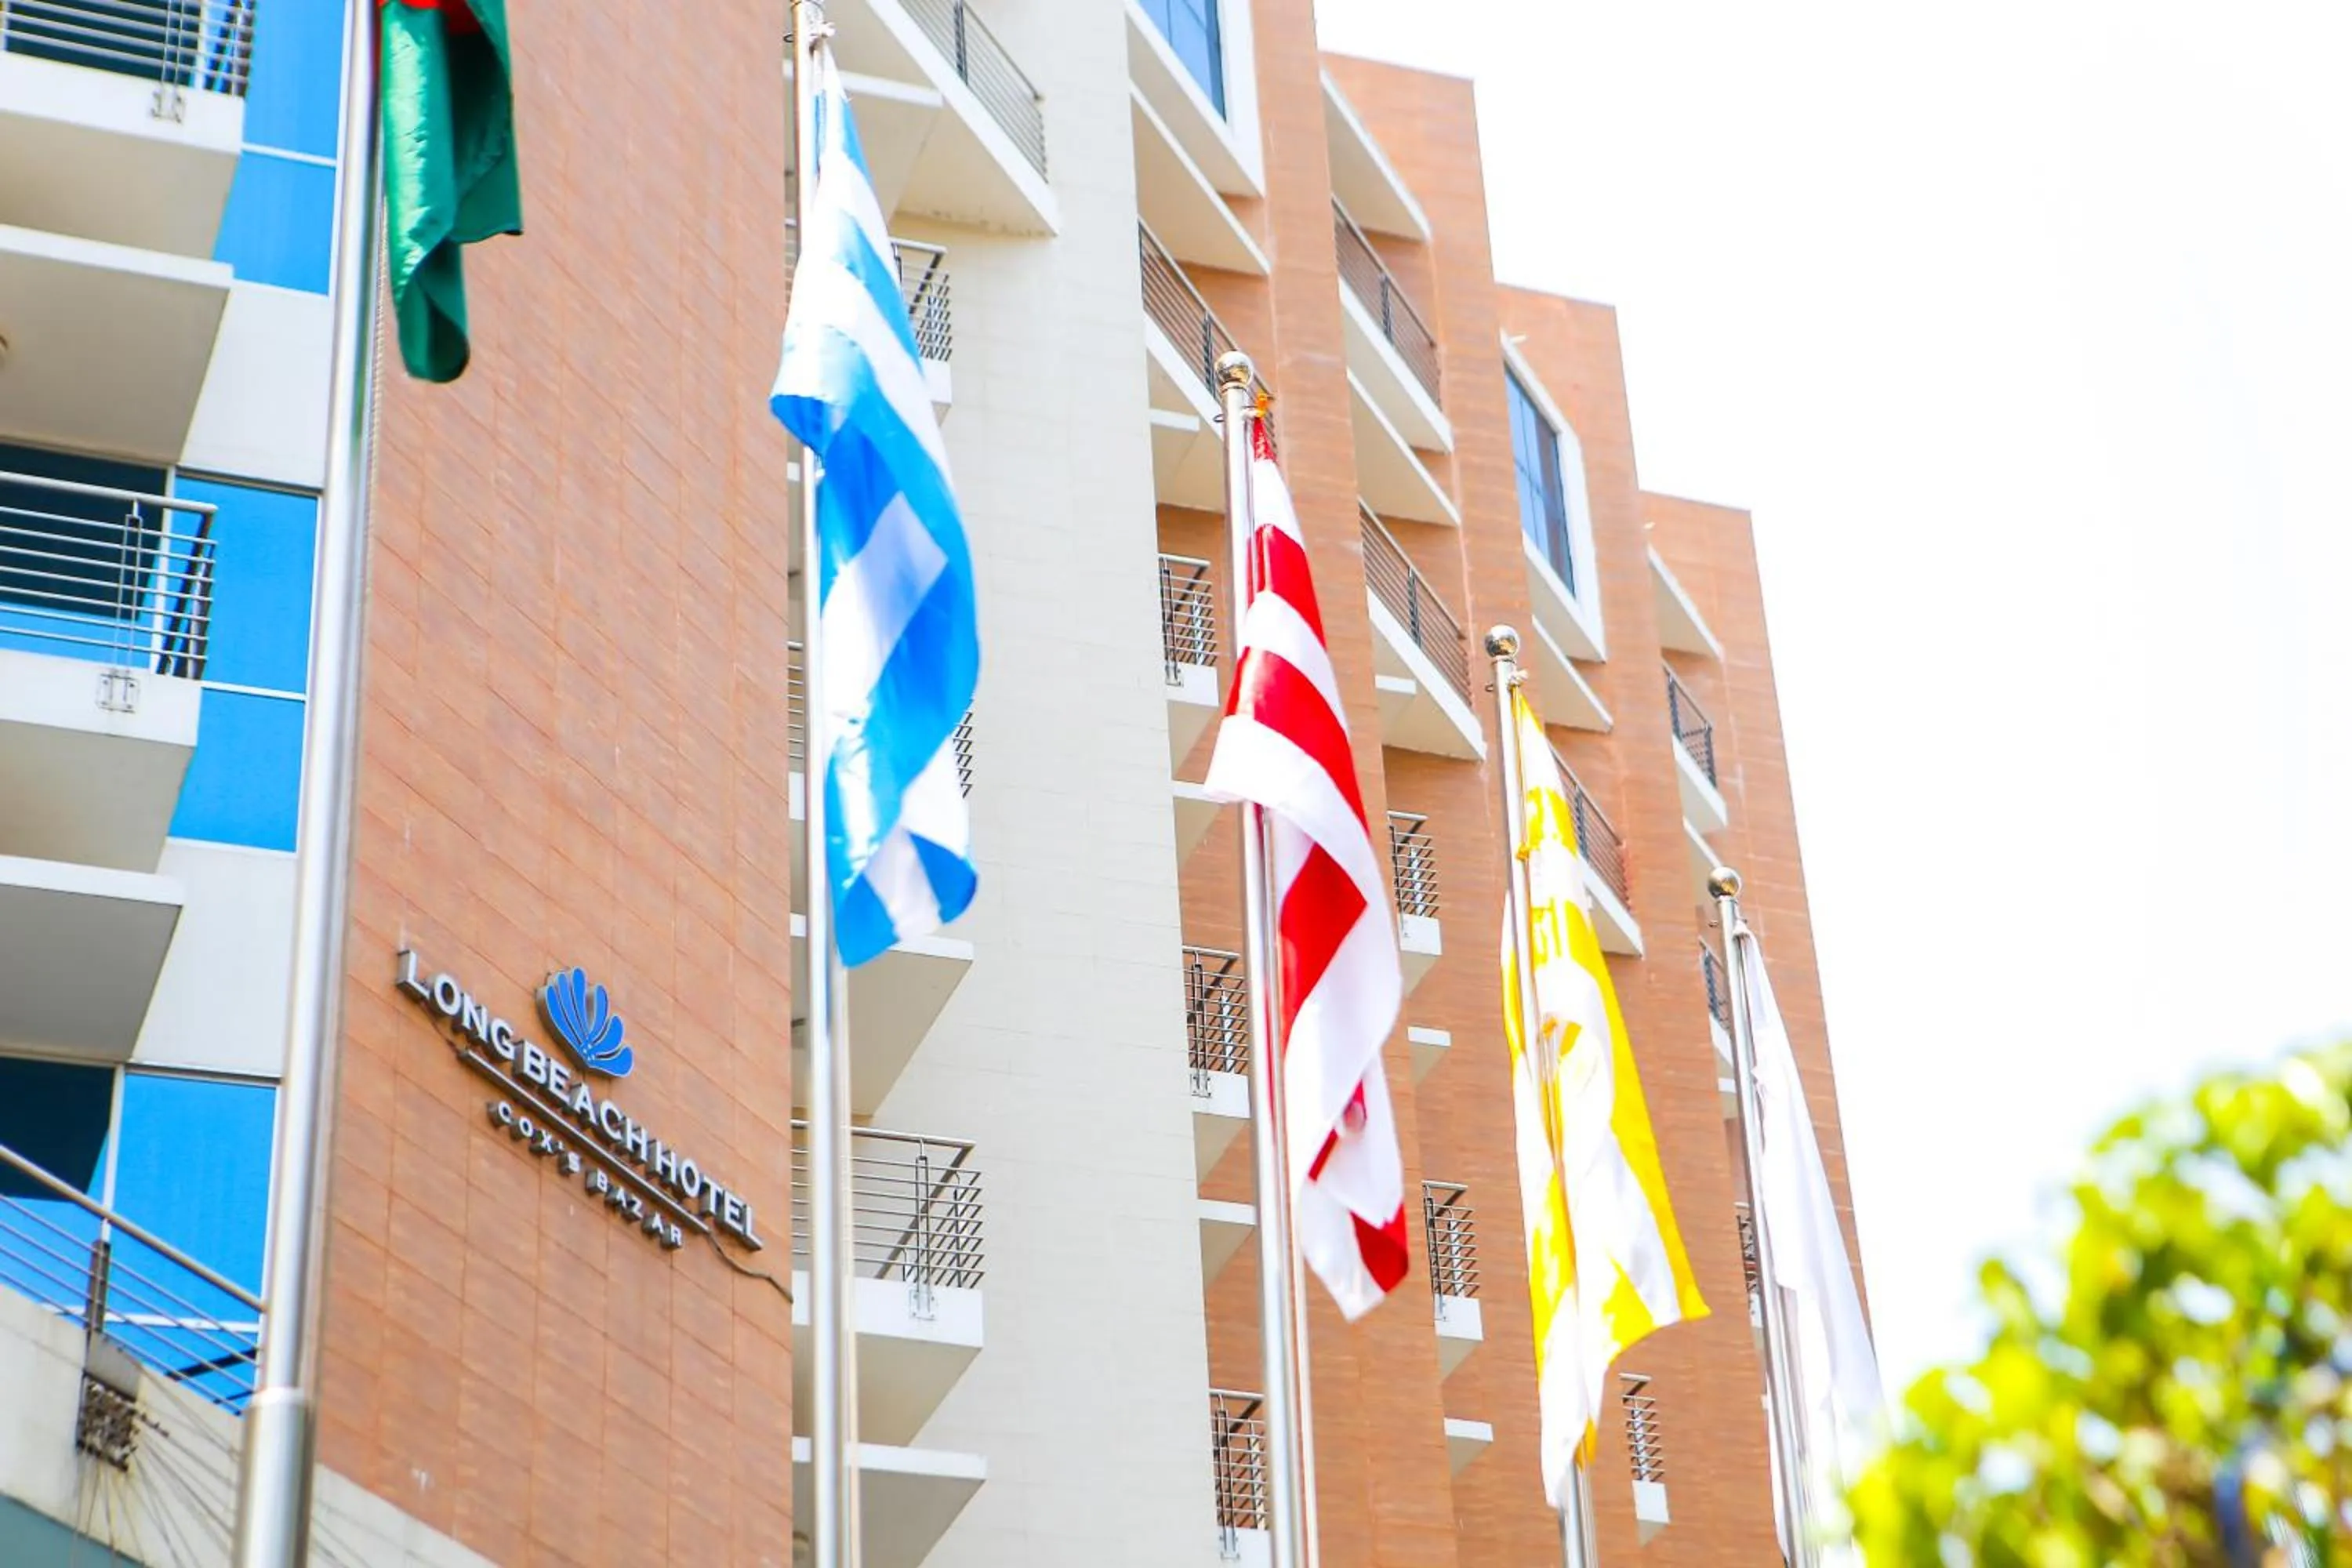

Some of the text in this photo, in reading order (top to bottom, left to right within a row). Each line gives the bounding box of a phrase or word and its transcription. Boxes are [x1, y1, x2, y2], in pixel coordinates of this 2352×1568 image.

[401, 949, 764, 1250] LONG BEACH HOTEL
[494, 1102, 682, 1247] COX'S BAZAR
